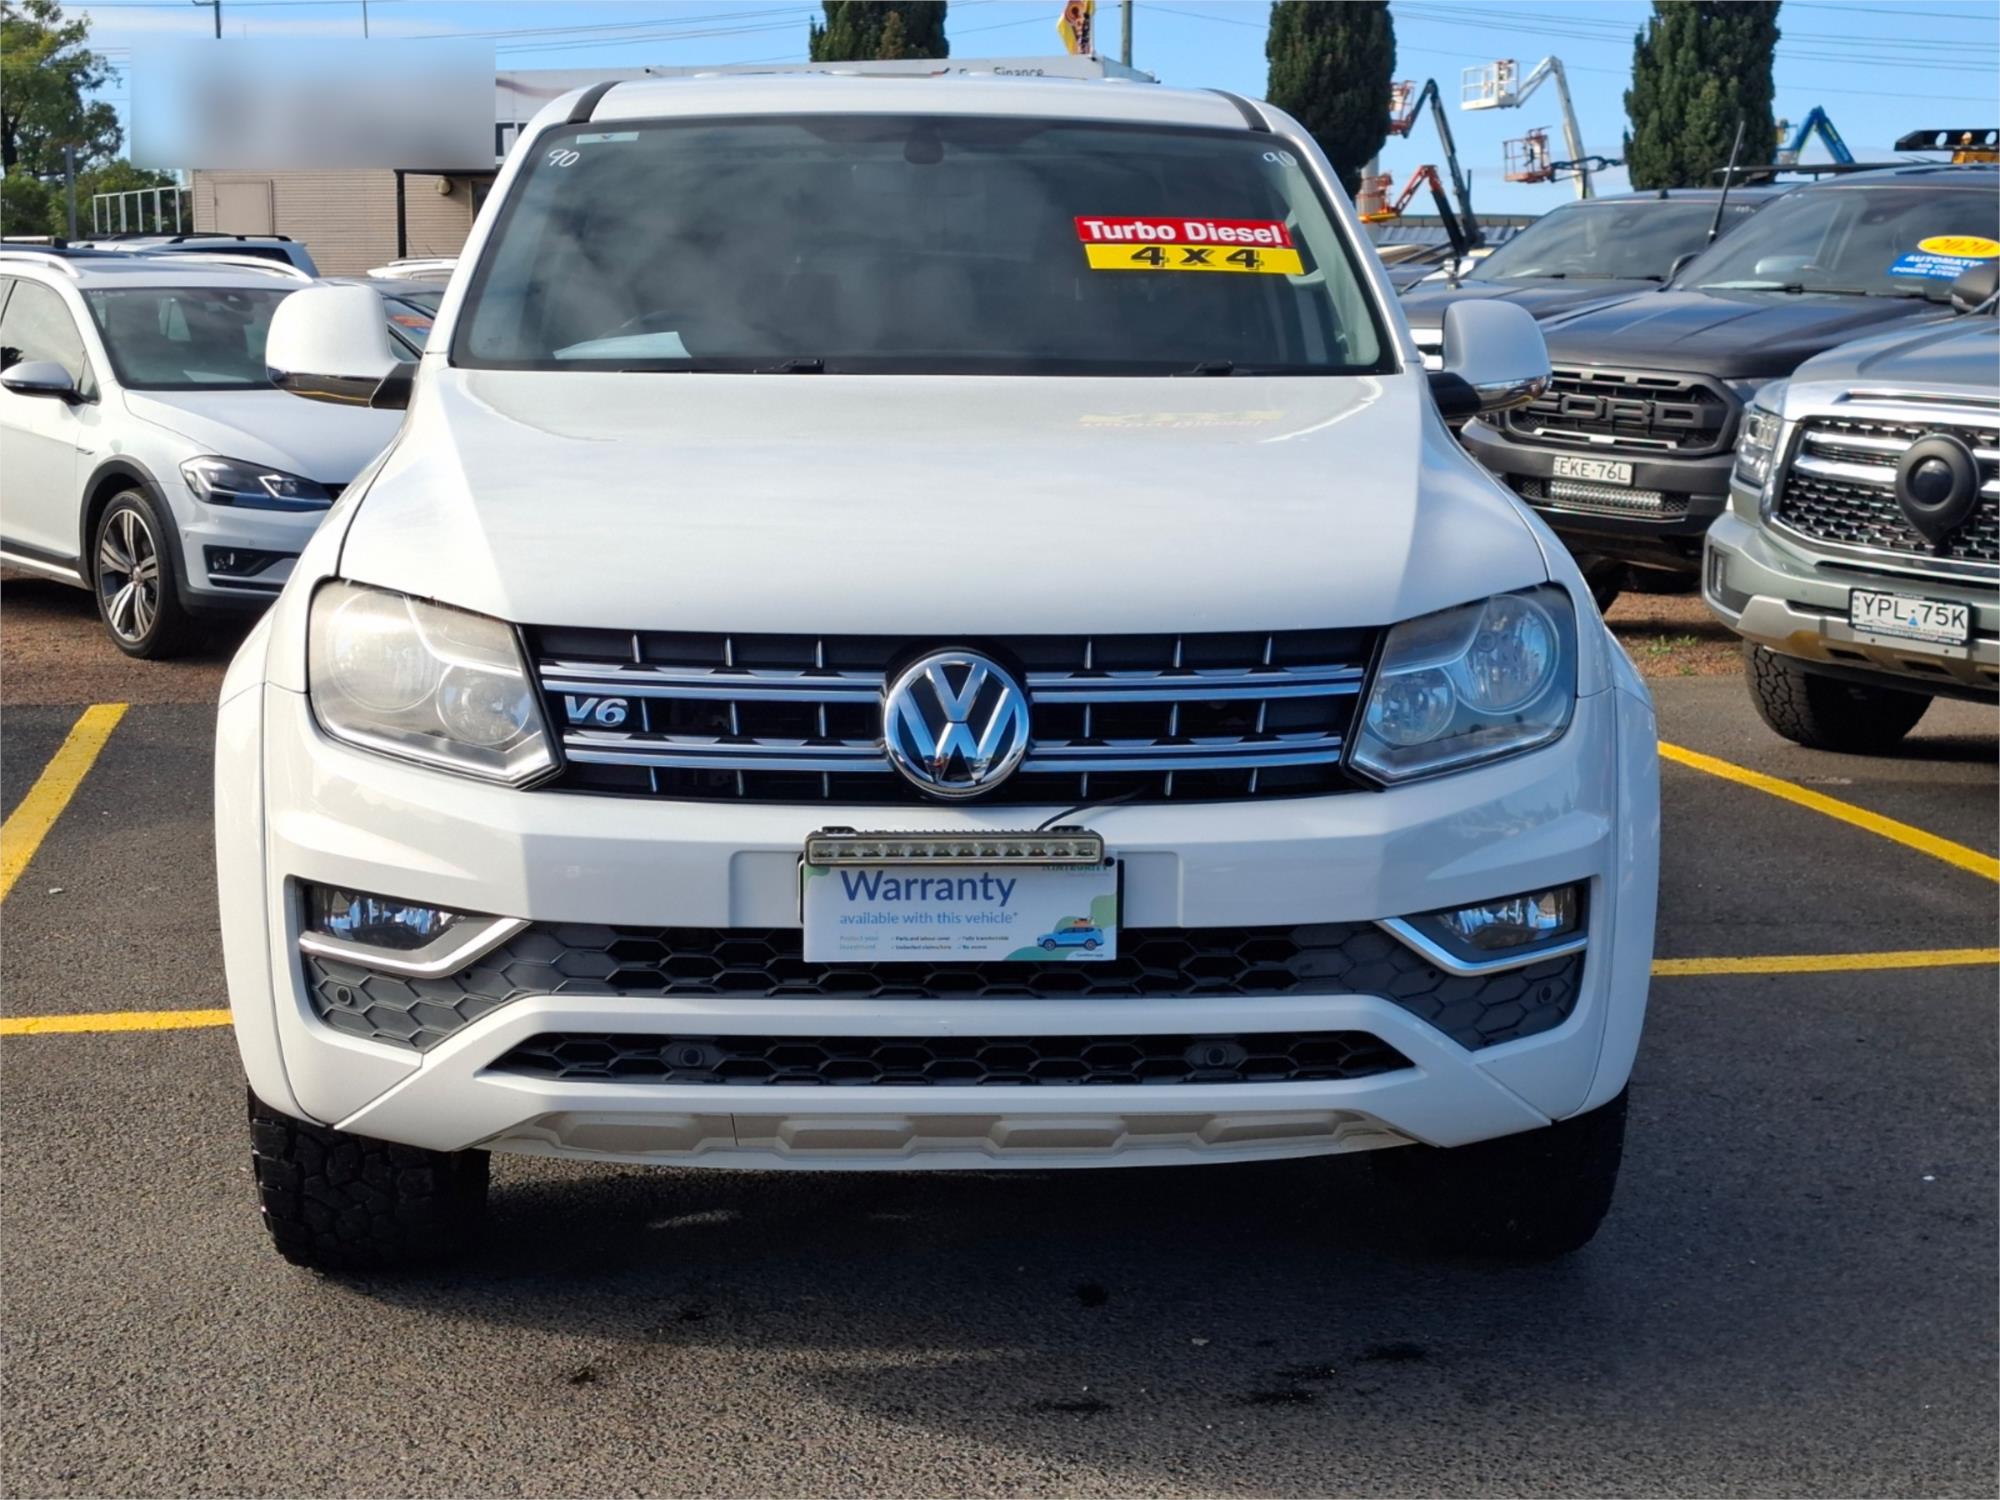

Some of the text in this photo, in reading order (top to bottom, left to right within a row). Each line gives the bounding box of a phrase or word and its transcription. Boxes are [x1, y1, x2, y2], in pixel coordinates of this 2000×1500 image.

[1083, 220, 1177, 241] Turbo
[1183, 221, 1283, 244] Diesel
[564, 694, 629, 727] V6
[840, 869, 1017, 908] Warranty
[840, 911, 898, 925] available
[902, 911, 933, 925] with
[936, 911, 961, 925] this
